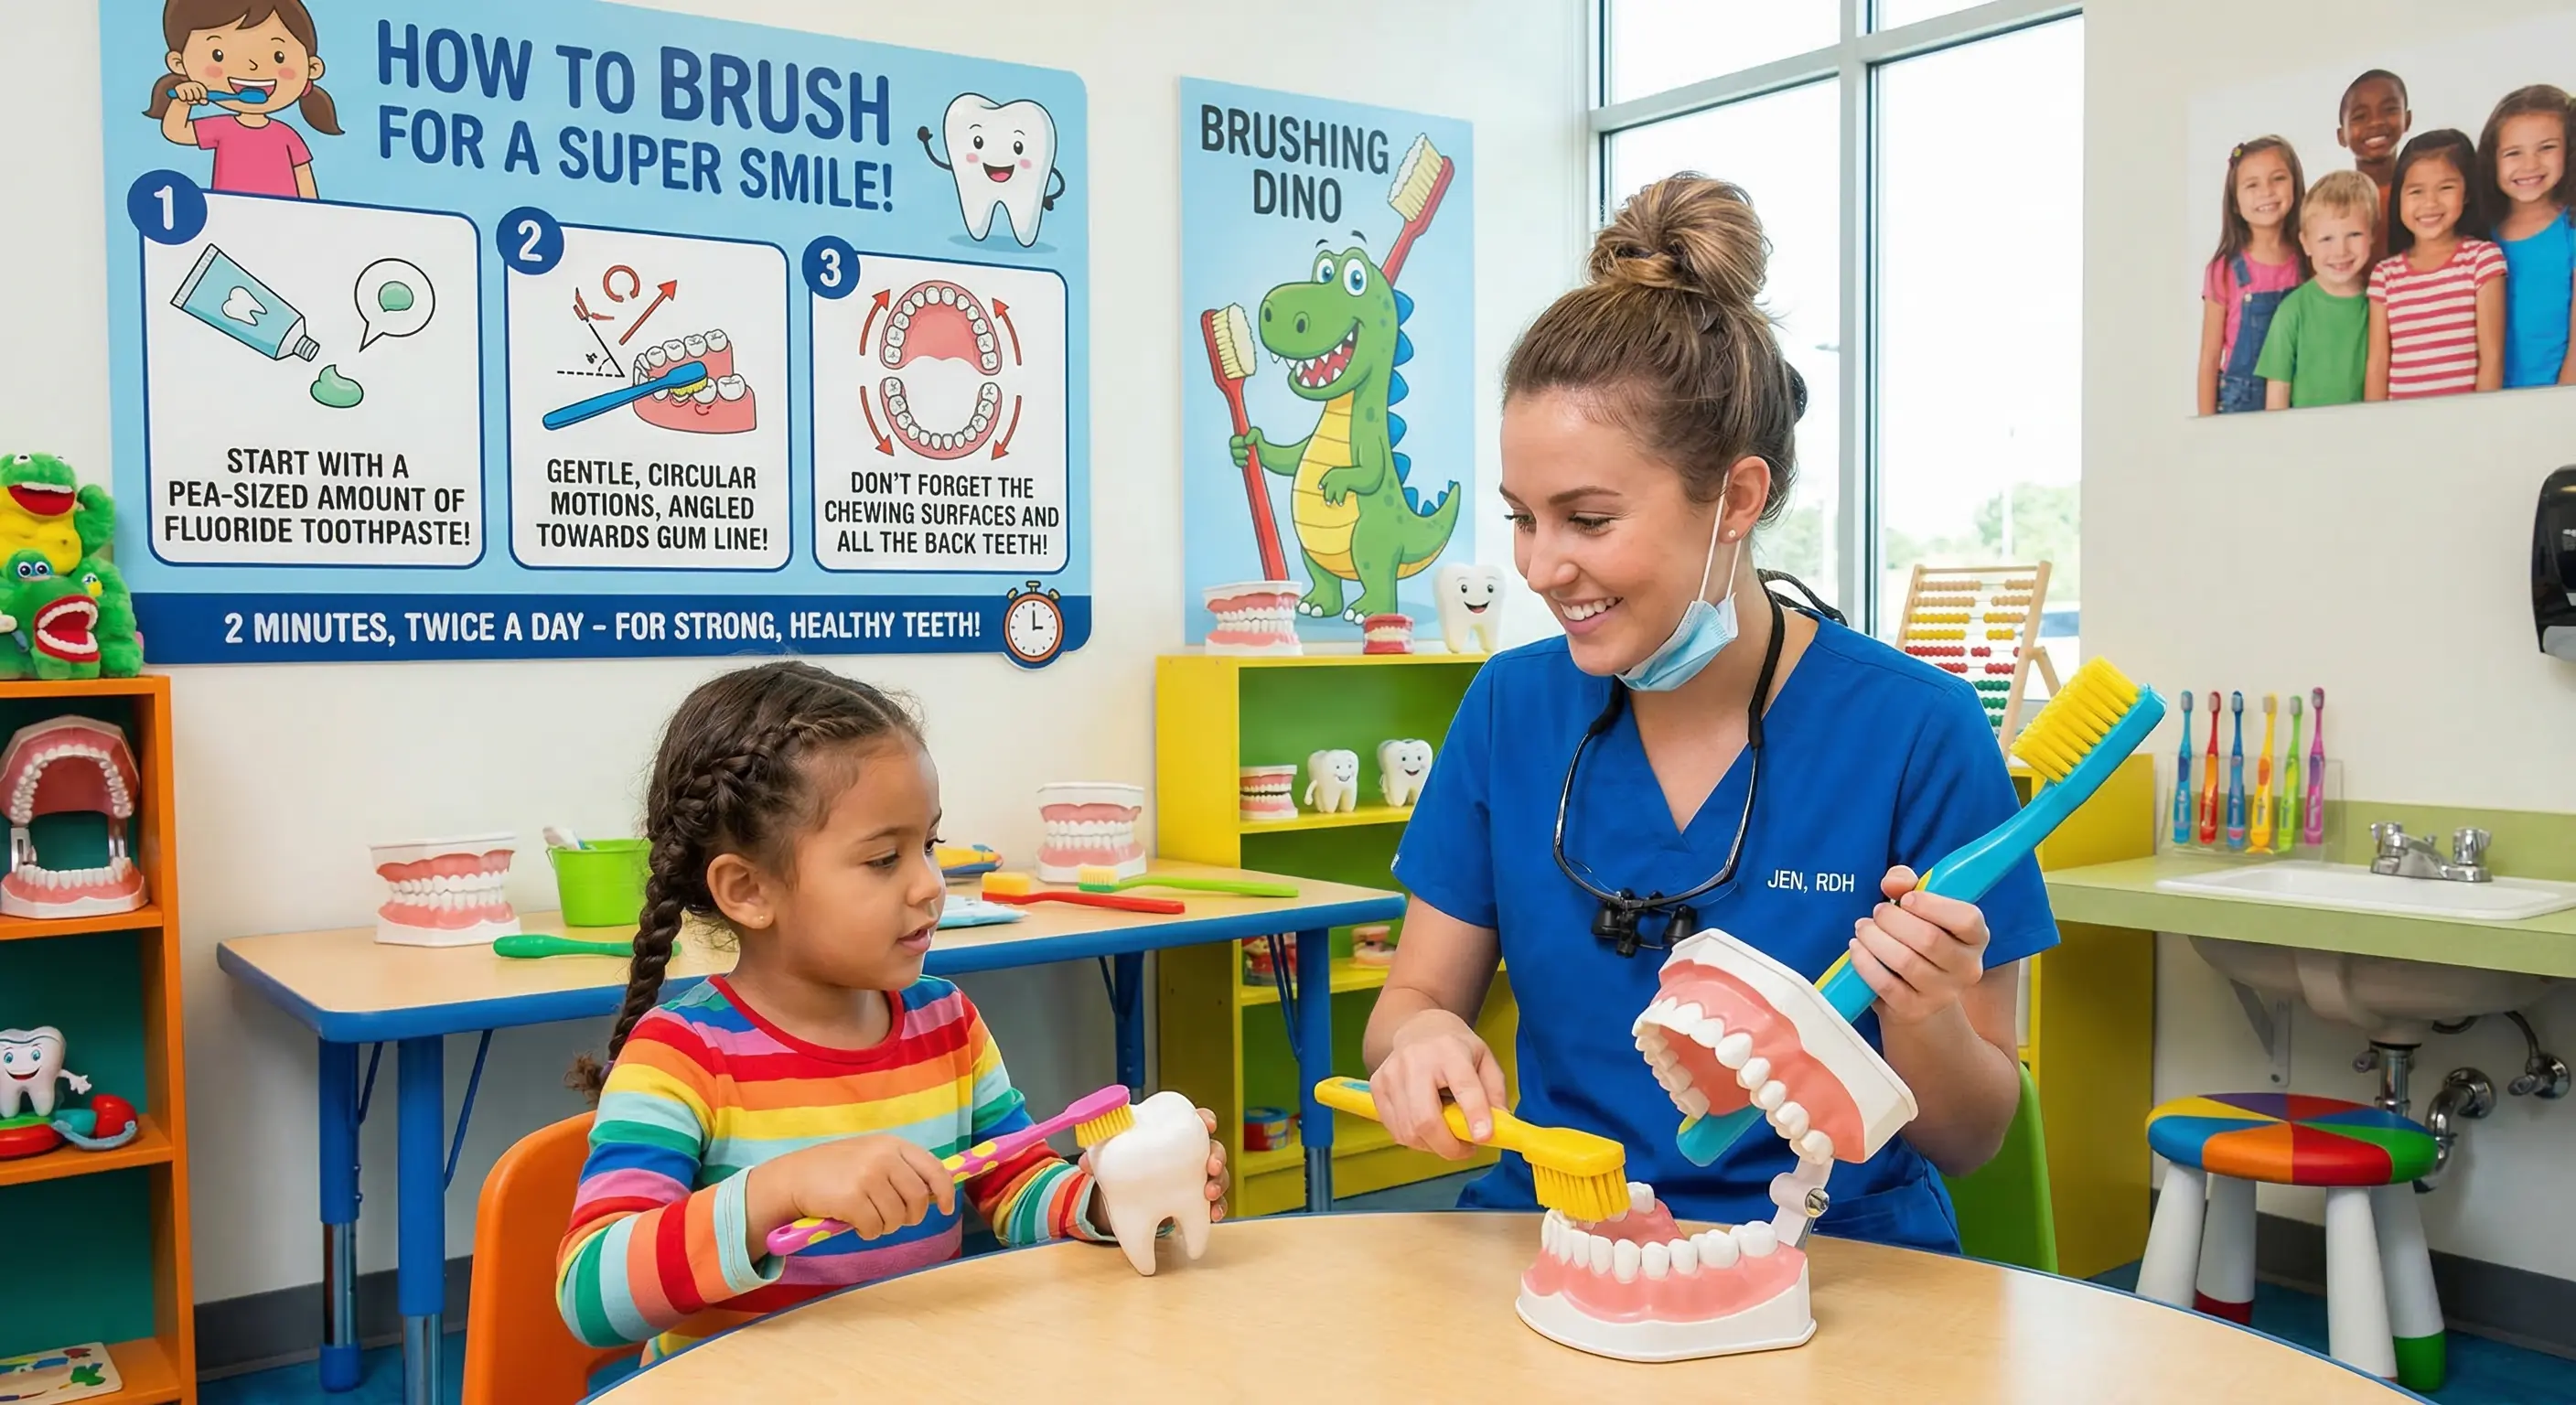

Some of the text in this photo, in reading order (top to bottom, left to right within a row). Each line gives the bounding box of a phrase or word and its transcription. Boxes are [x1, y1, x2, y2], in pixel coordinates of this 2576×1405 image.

[378, 18, 890, 146] HOW TO BRUSH
[1201, 103, 1389, 175] BRUSHING
[379, 104, 893, 213] FOR A SUPER SMILE!
[153, 185, 174, 231] 1
[1253, 168, 1342, 223] DINO
[518, 220, 542, 262] 2
[820, 248, 842, 287] 3
[227, 447, 409, 479] START WITH A
[547, 458, 757, 490] GENTLE, CIRCULAR
[169, 480, 466, 513] PEA-SIZED AMOUNT OF
[918, 473, 993, 498] FORGET
[997, 477, 1034, 499] THE
[551, 490, 755, 522] MOTIONS, ANGLED
[824, 499, 1059, 528] CHEWING SURFACES AND
[165, 515, 470, 546] FLUORIDE TOOTHPASTE!
[535, 522, 767, 552] TOWARDS GUM LINE!
[837, 530, 1047, 555] ALL THE BACK TEETH!
[224, 612, 243, 644] 2
[253, 612, 396, 648] MINUTES,
[403, 612, 496, 642] TWICE
[503, 612, 523, 641] A
[531, 612, 585, 641] DAY
[616, 611, 666, 640] FOR
[674, 611, 782, 643] STRONG,
[790, 611, 896, 639] HEALTHY
[902, 611, 981, 638] TEETH!
[1767, 869, 1855, 894] JEN, RDH
